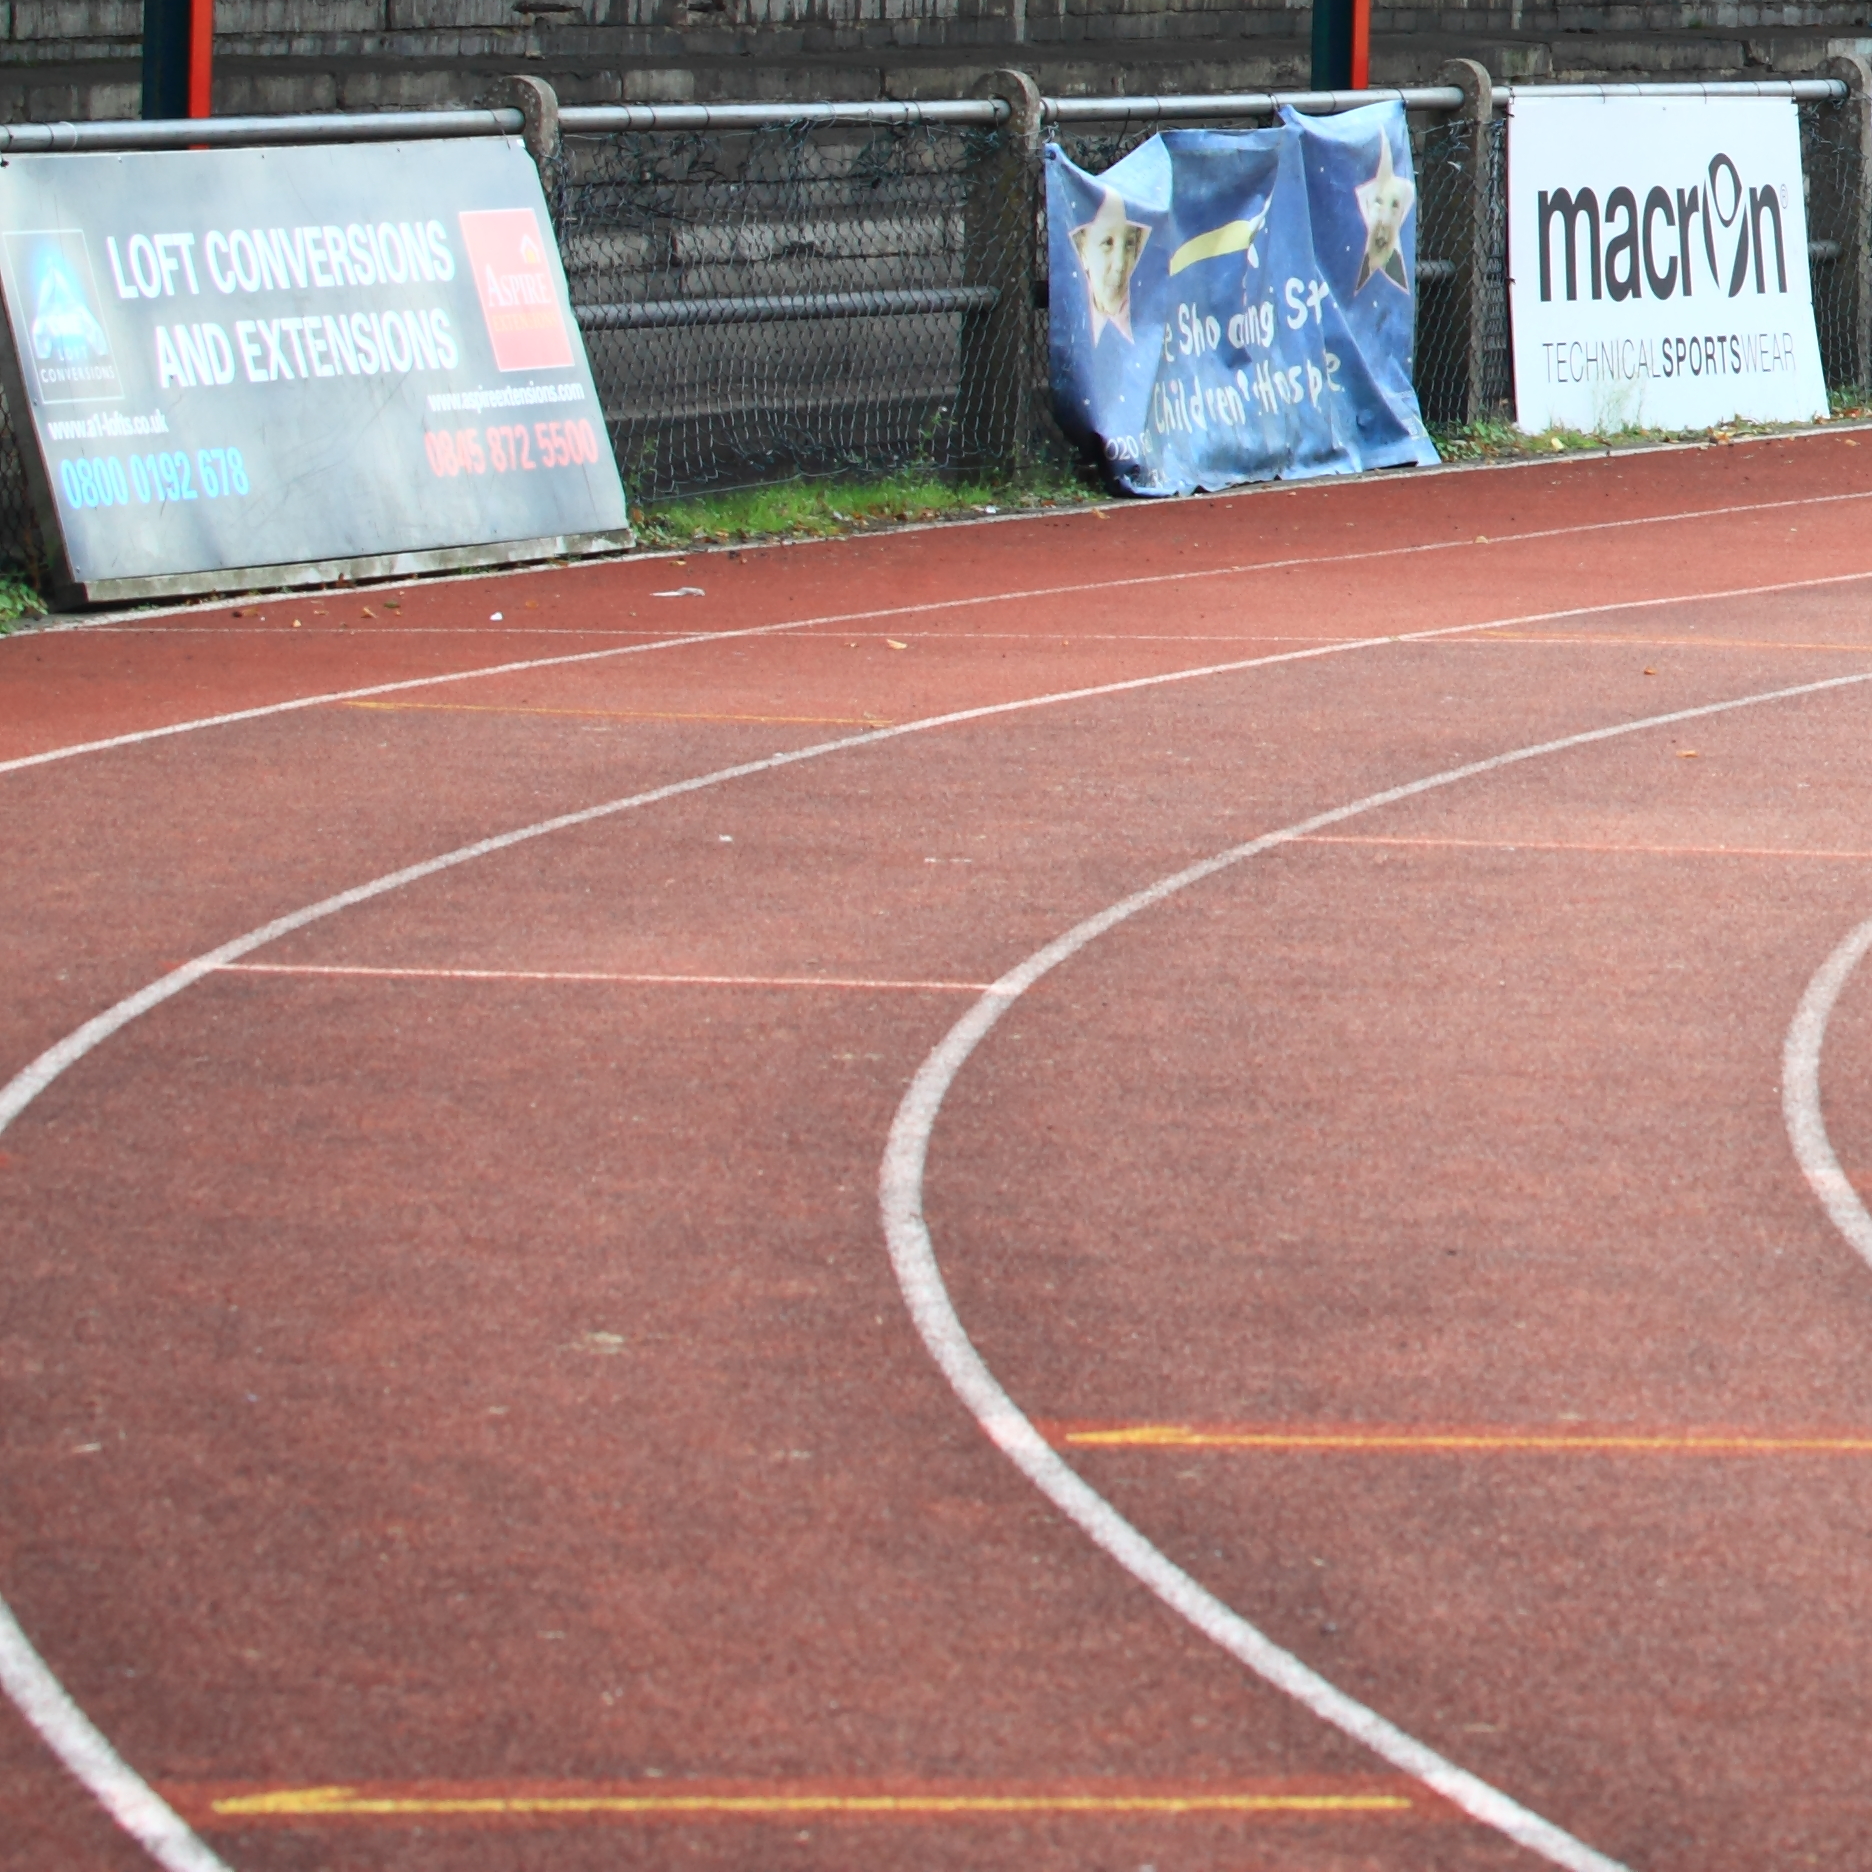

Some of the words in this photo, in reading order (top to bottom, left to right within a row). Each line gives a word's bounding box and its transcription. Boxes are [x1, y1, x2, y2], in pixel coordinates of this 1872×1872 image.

[1537, 152, 1788, 303] macron
[105, 231, 200, 300] LOFT
[204, 219, 456, 295] CONVERSIONS
[484, 262, 552, 308] ASPIRE
[155, 322, 236, 389] AND
[236, 307, 460, 384] EXTENSIONS
[491, 312, 558, 333] EXTENSIONS
[40, 365, 116, 384] CONVERSIONS
[1542, 331, 1797, 384] TECHNICALSPORTSWEAR
[426, 380, 585, 414] www.aspireextensions.com
[47, 408, 170, 441] www.a1-lofts.co.uk
[424, 429, 487, 478] 0845
[486, 424, 537, 473] 872
[536, 418, 600, 469] 5500
[60, 455, 129, 510] 0800
[129, 450, 199, 504] 0192
[197, 445, 250, 499] 678
